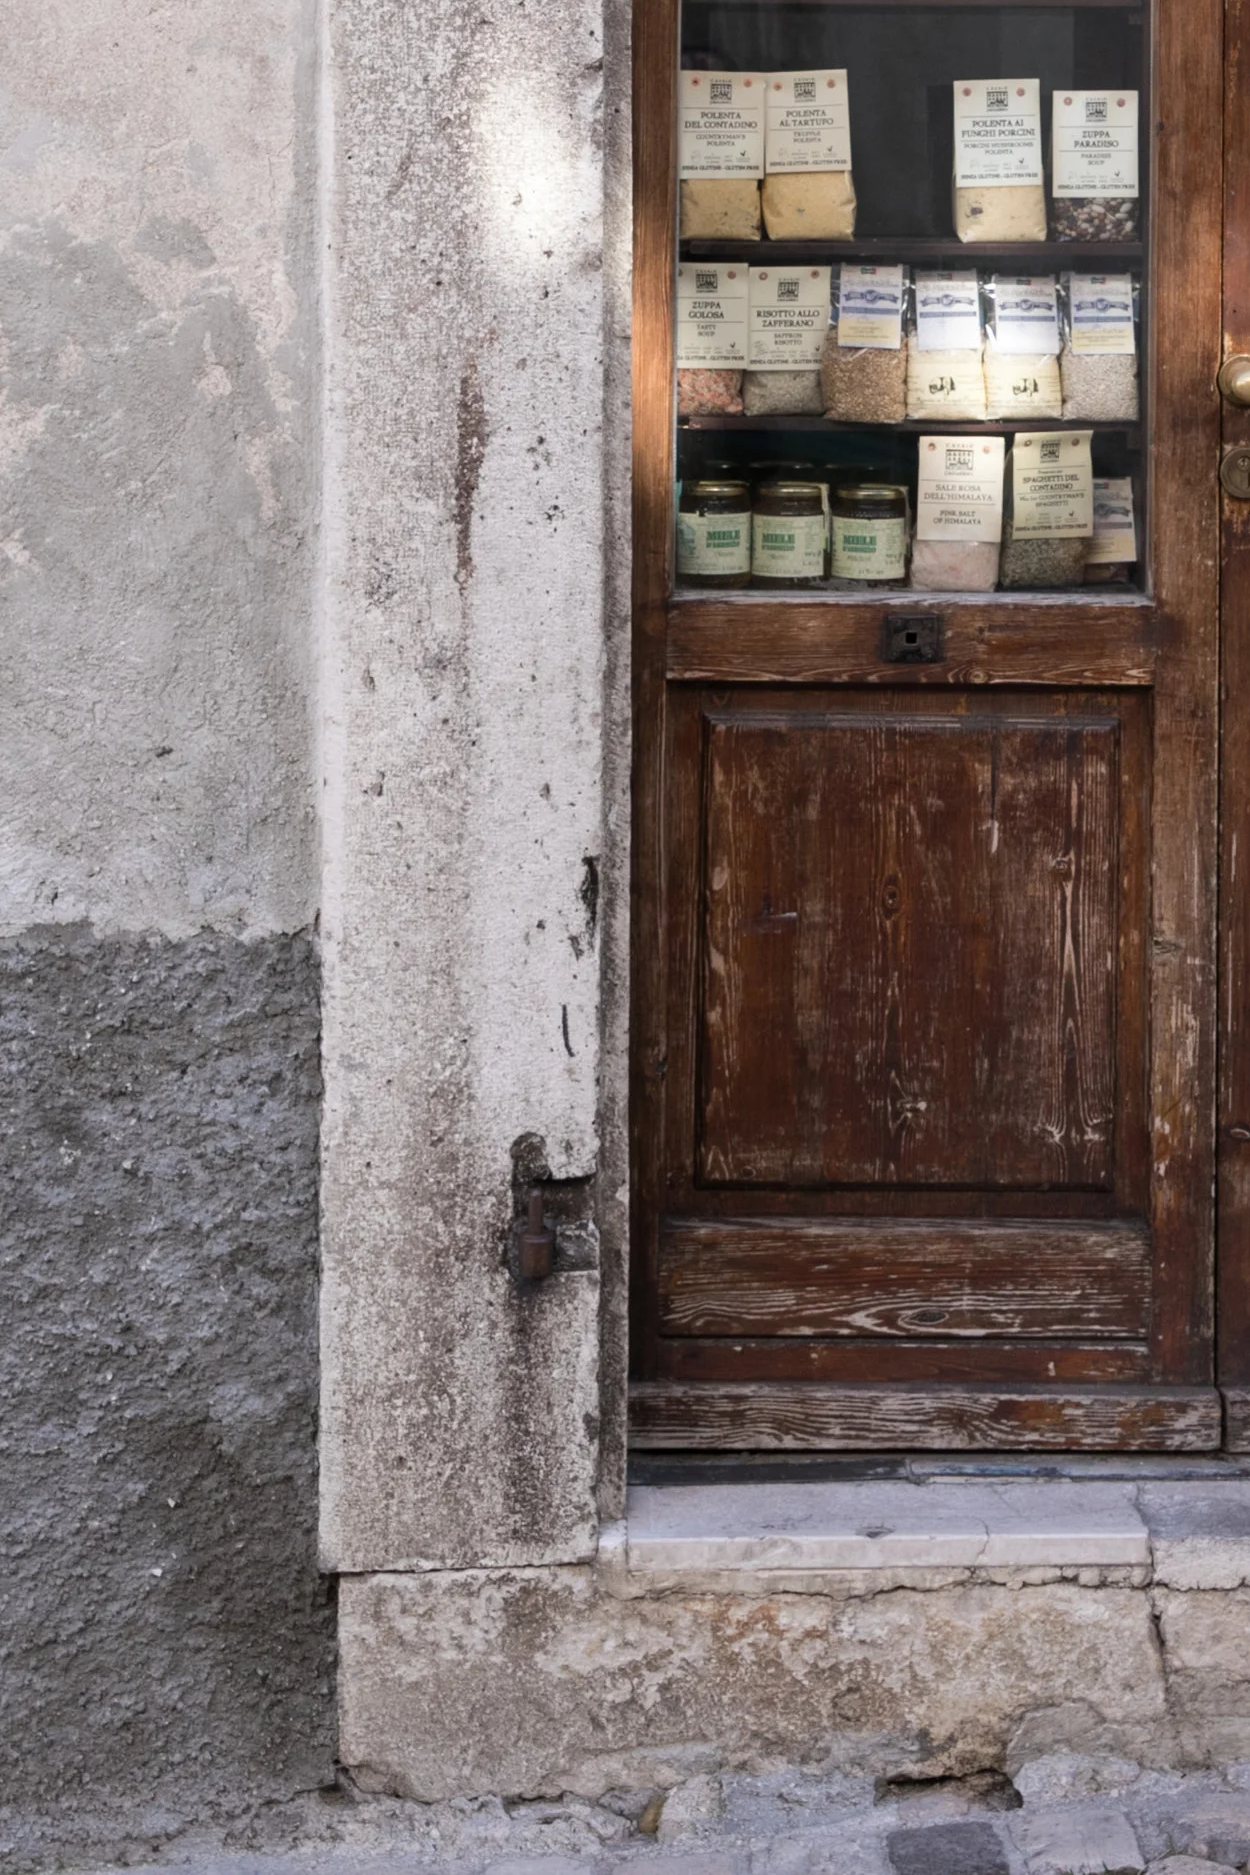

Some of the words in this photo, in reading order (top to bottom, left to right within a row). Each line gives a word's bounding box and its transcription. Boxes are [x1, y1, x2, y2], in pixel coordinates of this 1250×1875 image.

[700, 111, 742, 119] POLENTA
[785, 109, 827, 118] POLENTA
[684, 121, 703, 129] DEL
[703, 121, 758, 129] CONTADINO
[779, 119, 791, 127] AL
[791, 118, 834, 127] TARTUFO
[972, 119, 1013, 128] POLENTA
[961, 129, 996, 138] FUNGHI
[998, 128, 1035, 137] PORCINI
[1082, 130, 1111, 139] ZUPPA
[1073, 140, 1119, 148] PARADISO
[692, 301, 721, 309] ZUPPA
[688, 310, 725, 319] GOLOSA
[756, 310, 796, 318] RISOTTO
[797, 309, 820, 318] ALLO
[762, 319, 814, 328] ZAFFERANO
[1022, 475, 1064, 484] SPAGHETTI
[1065, 474, 1080, 482] DEL
[958, 484, 981, 492] ROSA
[1029, 483, 1073, 492] CONTADINO
[923, 492, 993, 501] DELL'HIMALAYA
[706, 529, 740, 541] MIELE
[762, 533, 795, 544] MIELE
[843, 535, 877, 545] MIELE
